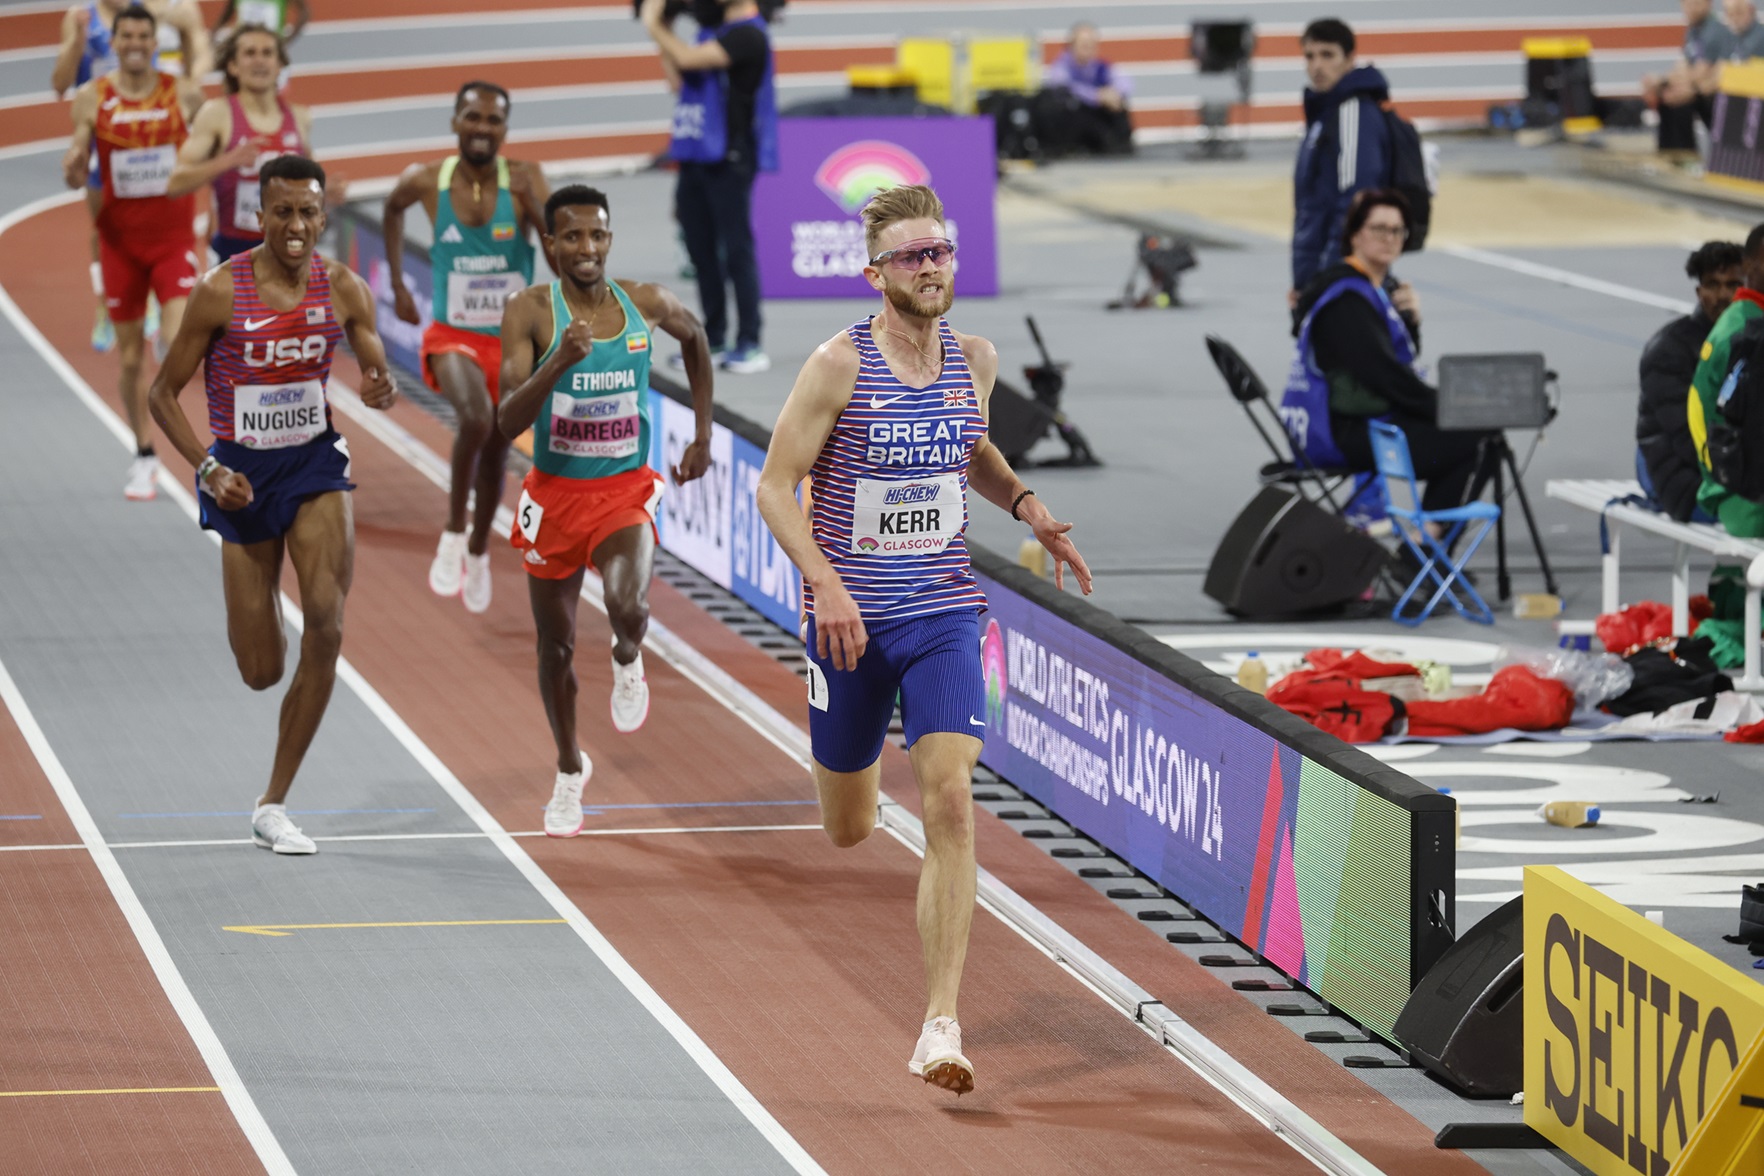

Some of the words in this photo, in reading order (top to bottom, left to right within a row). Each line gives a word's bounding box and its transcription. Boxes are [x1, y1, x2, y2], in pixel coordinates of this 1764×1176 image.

[792, 253, 864, 278] GLAS
[243, 335, 327, 367] USA
[572, 369, 636, 391] ETHIOPIA
[243, 406, 319, 431] NUGUSE
[556, 418, 635, 440] BAREGA
[261, 432, 310, 446] GLASGOW
[868, 420, 966, 443] GREAT
[573, 443, 623, 454] GLASGOW
[866, 444, 966, 465] BRITAIN
[883, 484, 940, 504] HI-CHEW
[523, 505, 532, 529] 6
[879, 508, 940, 535] KERR
[883, 537, 944, 551] GLASGOW
[1007, 627, 1047, 704] WORLD
[1047, 652, 1109, 744] ATHLETICS
[1007, 700, 1040, 762] INDOOR
[1039, 721, 1109, 806] CHAMPIONSHIPS
[1111, 708, 1200, 843] GLASGOW
[1202, 761, 1224, 862] 24
